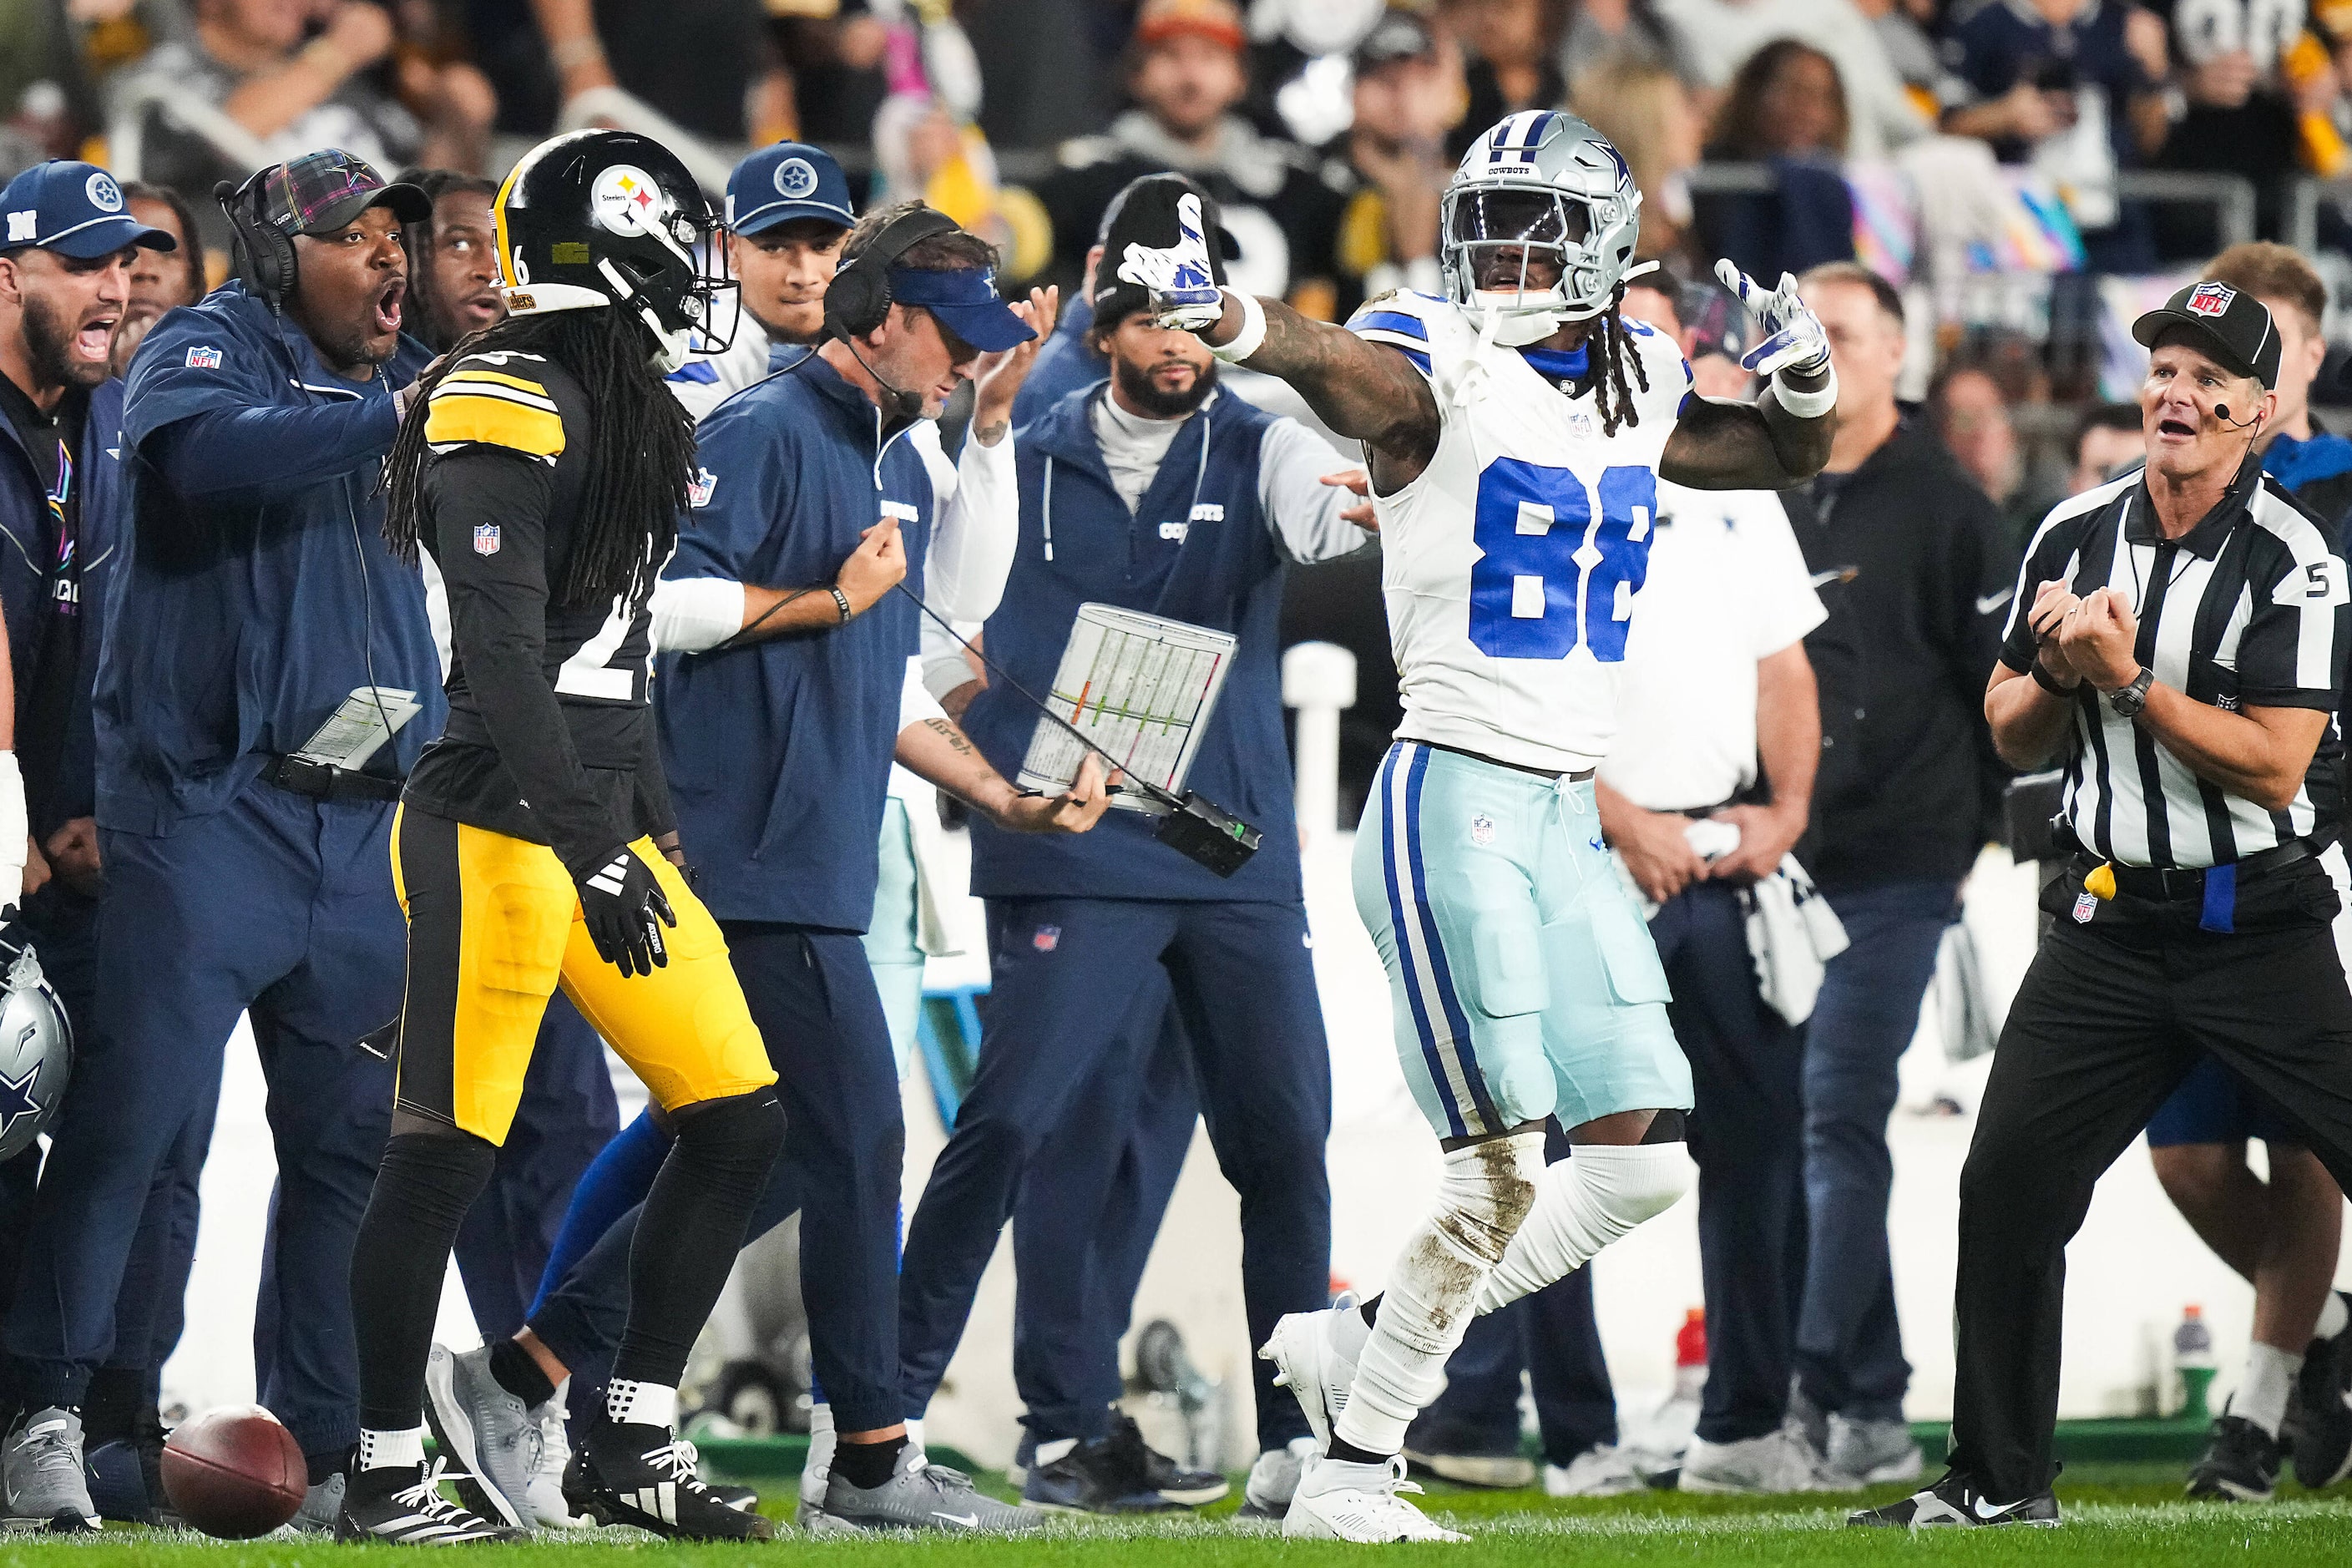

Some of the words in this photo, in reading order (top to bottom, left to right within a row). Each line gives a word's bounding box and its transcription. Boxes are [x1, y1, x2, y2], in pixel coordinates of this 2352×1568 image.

[2191, 294, 2222, 313] NFL
[191, 357, 214, 367] NFL
[477, 537, 497, 551] NFL
[1469, 456, 1657, 663] 88
[2305, 562, 2330, 598] 5
[2076, 904, 2092, 919] NFL
[646, 922, 662, 953] ADIZERO
[421, 1460, 430, 1485] ADIZ
